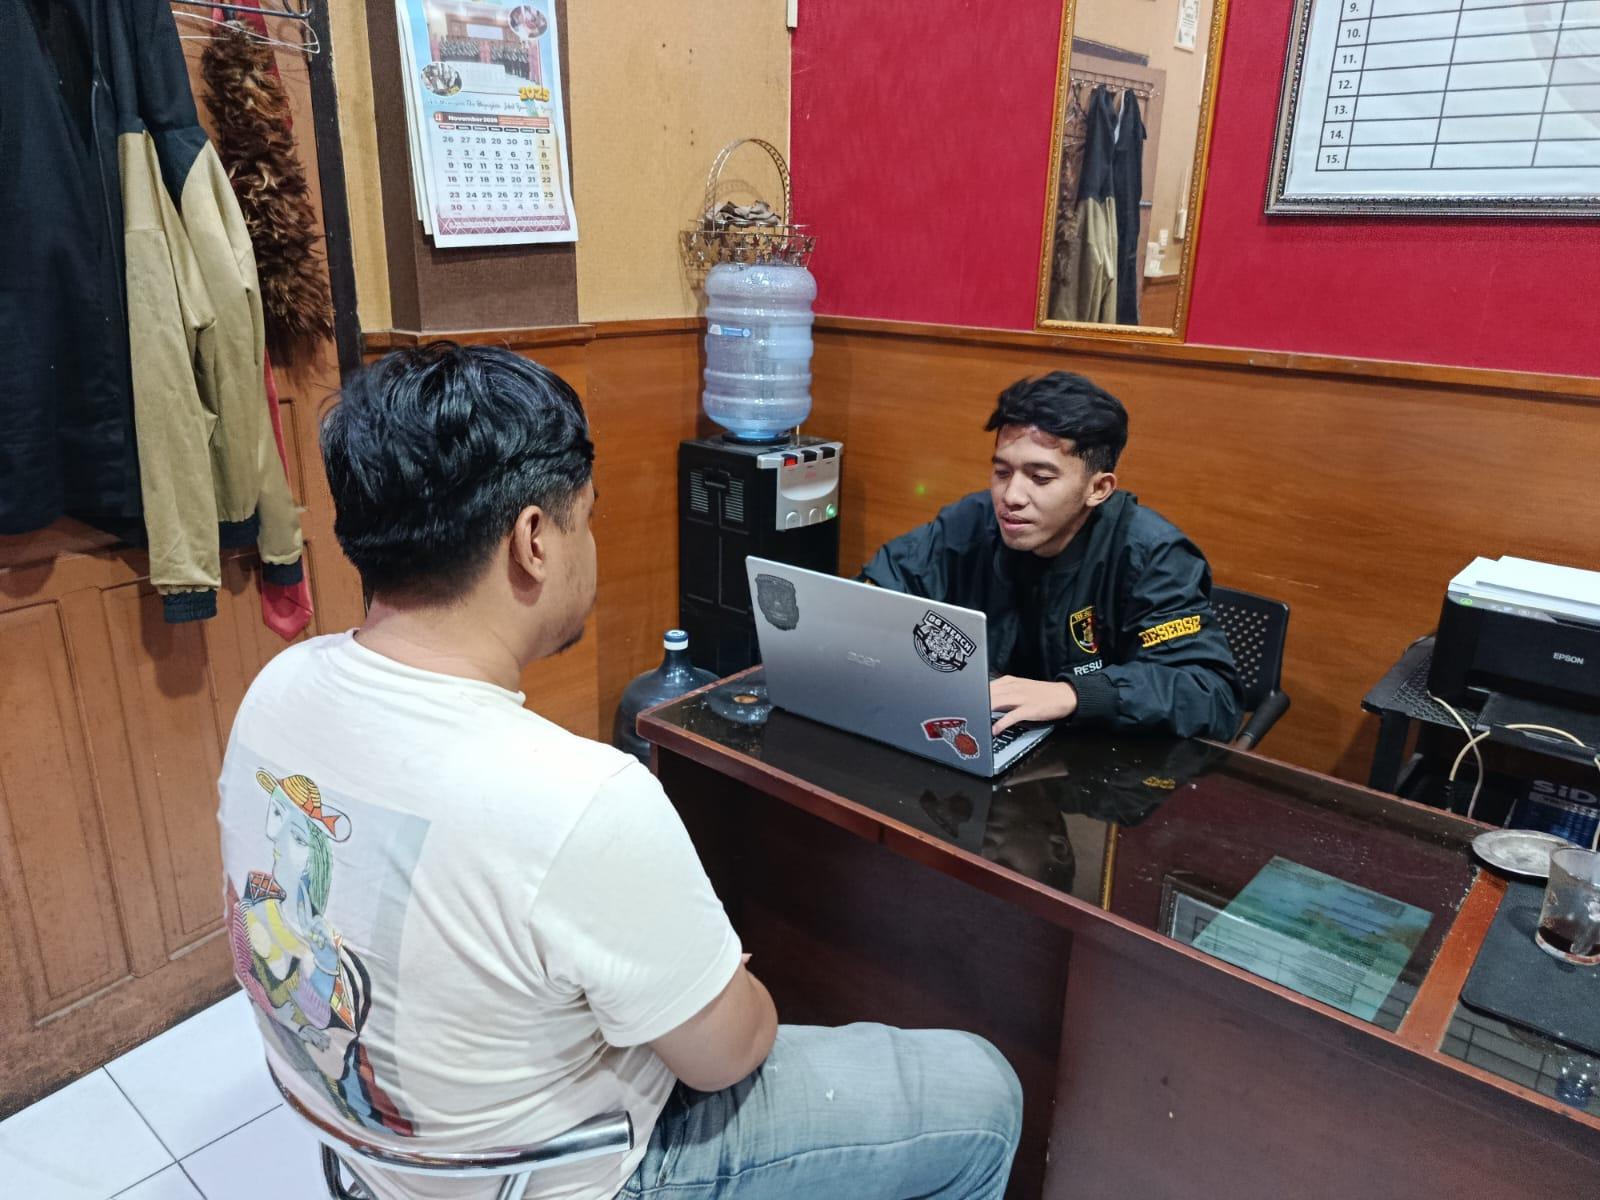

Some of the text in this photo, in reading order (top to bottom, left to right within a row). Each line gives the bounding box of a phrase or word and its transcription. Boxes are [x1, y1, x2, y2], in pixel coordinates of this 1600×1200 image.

[1347, 28, 1361, 38] 10.
[1342, 54, 1357, 64] 11.
[1338, 80, 1352, 90] 12.
[1334, 105, 1348, 115] 13.
[1330, 130, 1344, 139] 14.
[1325, 155, 1340, 164] 15.
[942, 624, 972, 651] MERCH
[1553, 652, 1584, 664] EPSON
